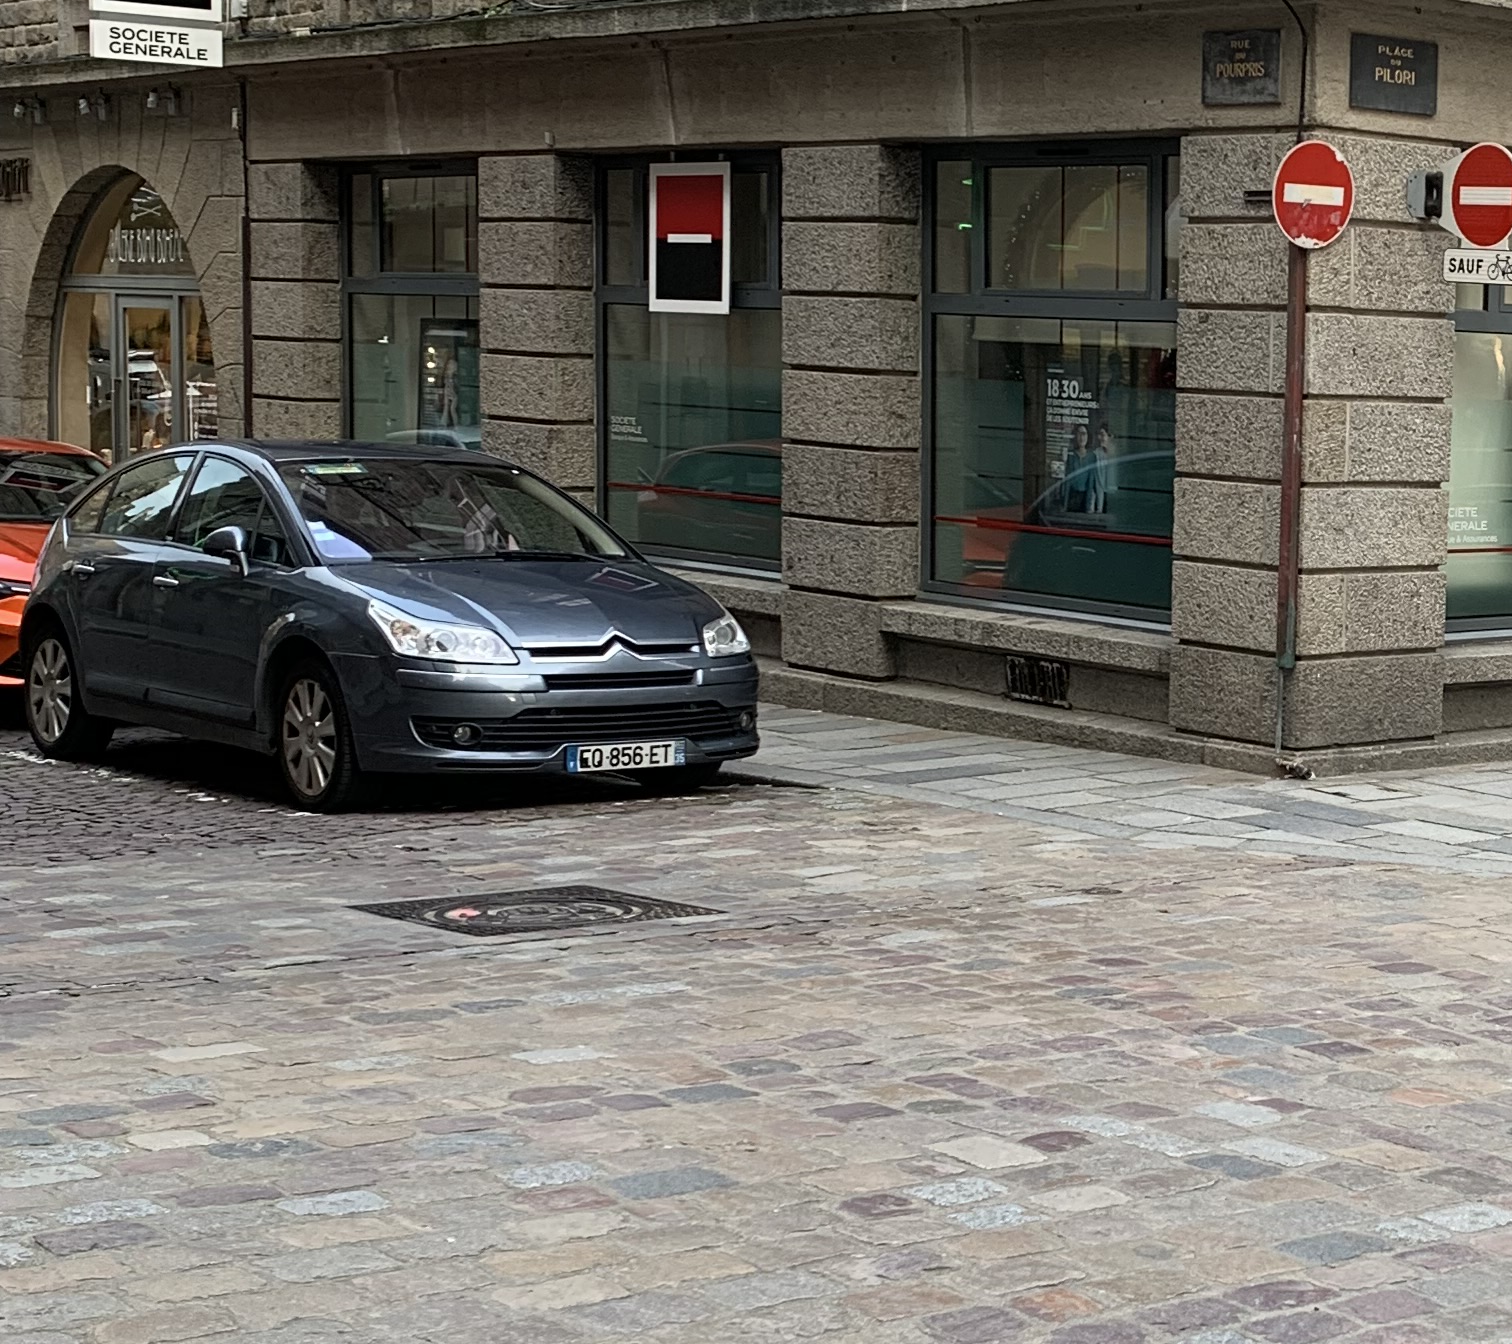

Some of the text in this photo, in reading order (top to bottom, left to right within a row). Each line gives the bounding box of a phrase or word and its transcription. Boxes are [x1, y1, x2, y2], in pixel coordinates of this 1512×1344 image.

[109, 27, 189, 45] SOCIETE
[109, 41, 208, 61] GENERALE
[1230, 40, 1251, 49] RUE
[1378, 44, 1414, 58] PLACE
[1216, 62, 1265, 77] POURPRIS
[1375, 67, 1415, 85] PILORI
[1448, 258, 1484, 274] SAUF
[1448, 507, 1478, 517] CIETE
